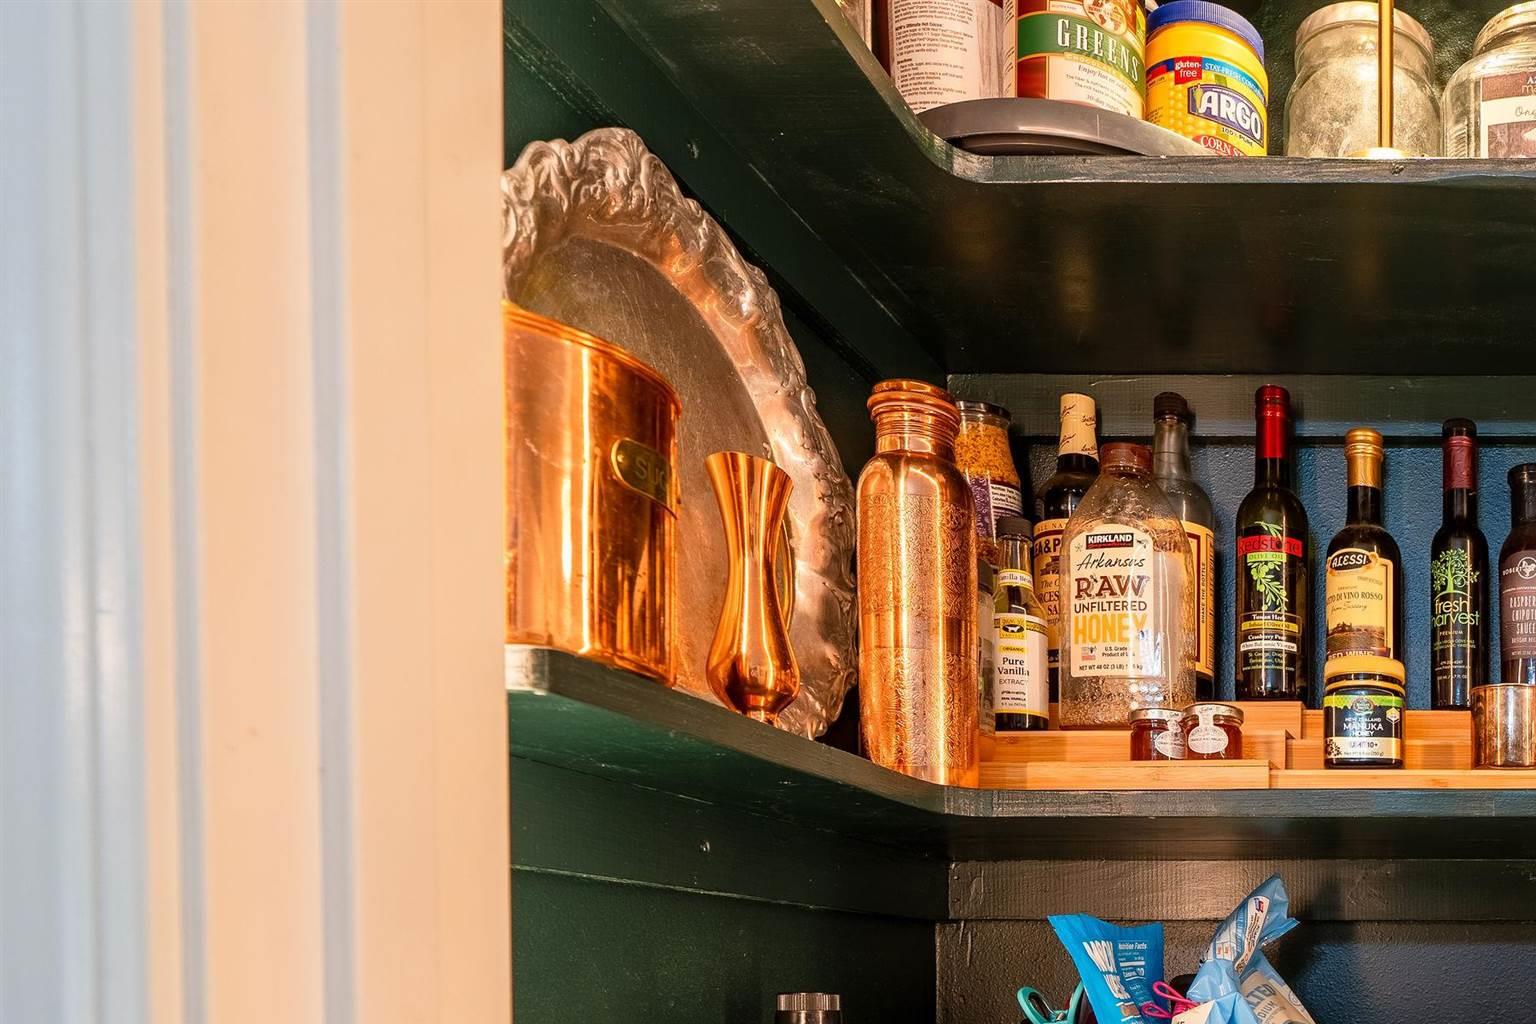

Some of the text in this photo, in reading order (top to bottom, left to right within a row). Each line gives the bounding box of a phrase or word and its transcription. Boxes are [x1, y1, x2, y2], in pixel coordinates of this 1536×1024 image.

[1057, 18, 1140, 82] GREENS
[1174, 60, 1202, 71] gluten-
[1179, 68, 1198, 78] free
[1199, 90, 1262, 141] ARGO
[1200, 135, 1232, 156] CORN
[1087, 534, 1133, 544] KIRKLAND
[1076, 552, 1147, 572] Arkansas
[1331, 554, 1367, 569] ALESSI
[1074, 574, 1151, 600] RAW
[1343, 591, 1360, 600] VINO
[1360, 591, 1384, 601] ROSSO
[1074, 600, 1148, 614] UNFILTERED
[1434, 596, 1470, 615] fresh
[1073, 613, 1148, 645] HONEY
[1516, 622, 1536, 635] SAUCE
[1002, 656, 1025, 666] Pure
[997, 666, 1030, 677] Vanilla
[998, 678, 1029, 686] EXTRAC
[1343, 723, 1384, 731] MANUKA
